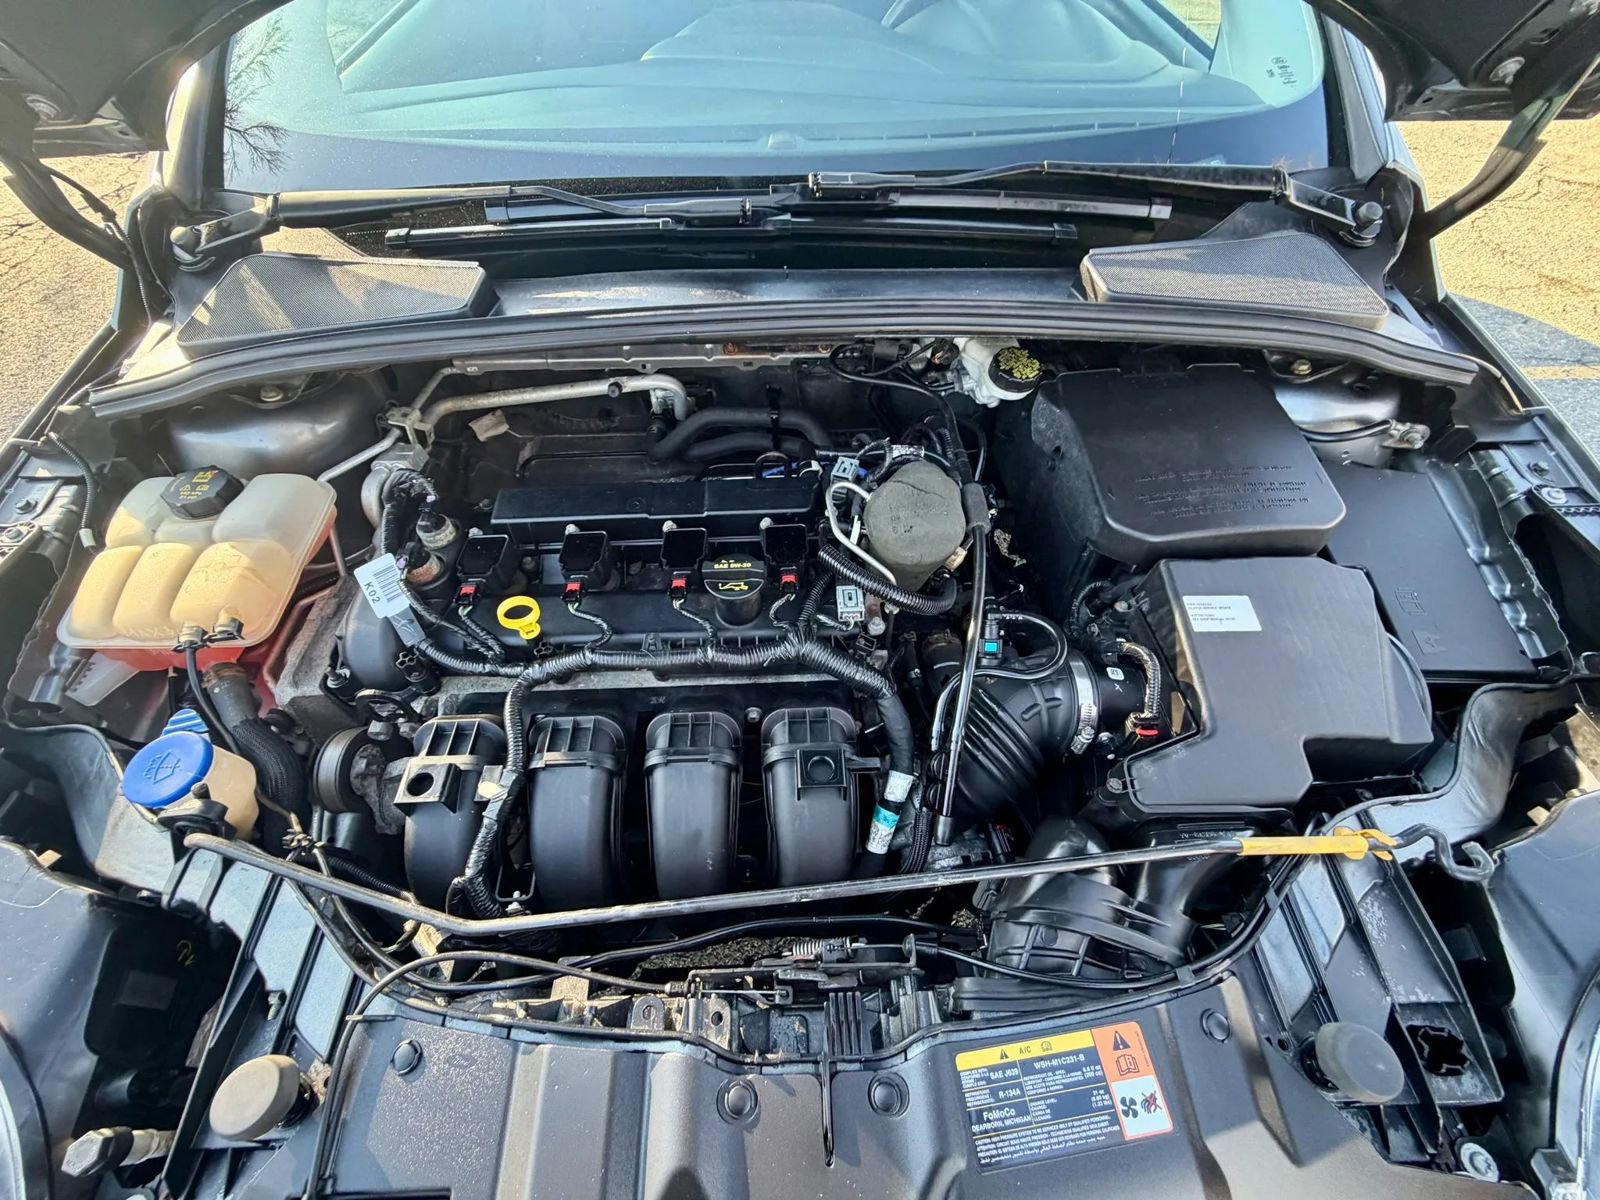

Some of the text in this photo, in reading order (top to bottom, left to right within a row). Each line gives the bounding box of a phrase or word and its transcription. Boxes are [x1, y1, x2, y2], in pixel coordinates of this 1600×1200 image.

[365, 582, 380, 604] K02
[1019, 1046, 1031, 1055] A/C
[990, 1070, 1004, 1080] SAE
[999, 1088, 1021, 1099] R-134A
[983, 1107, 1016, 1122] FoMoCo
[972, 1120, 1004, 1133] DEARBORN,
[1005, 1115, 1032, 1126] MICHIGAN
